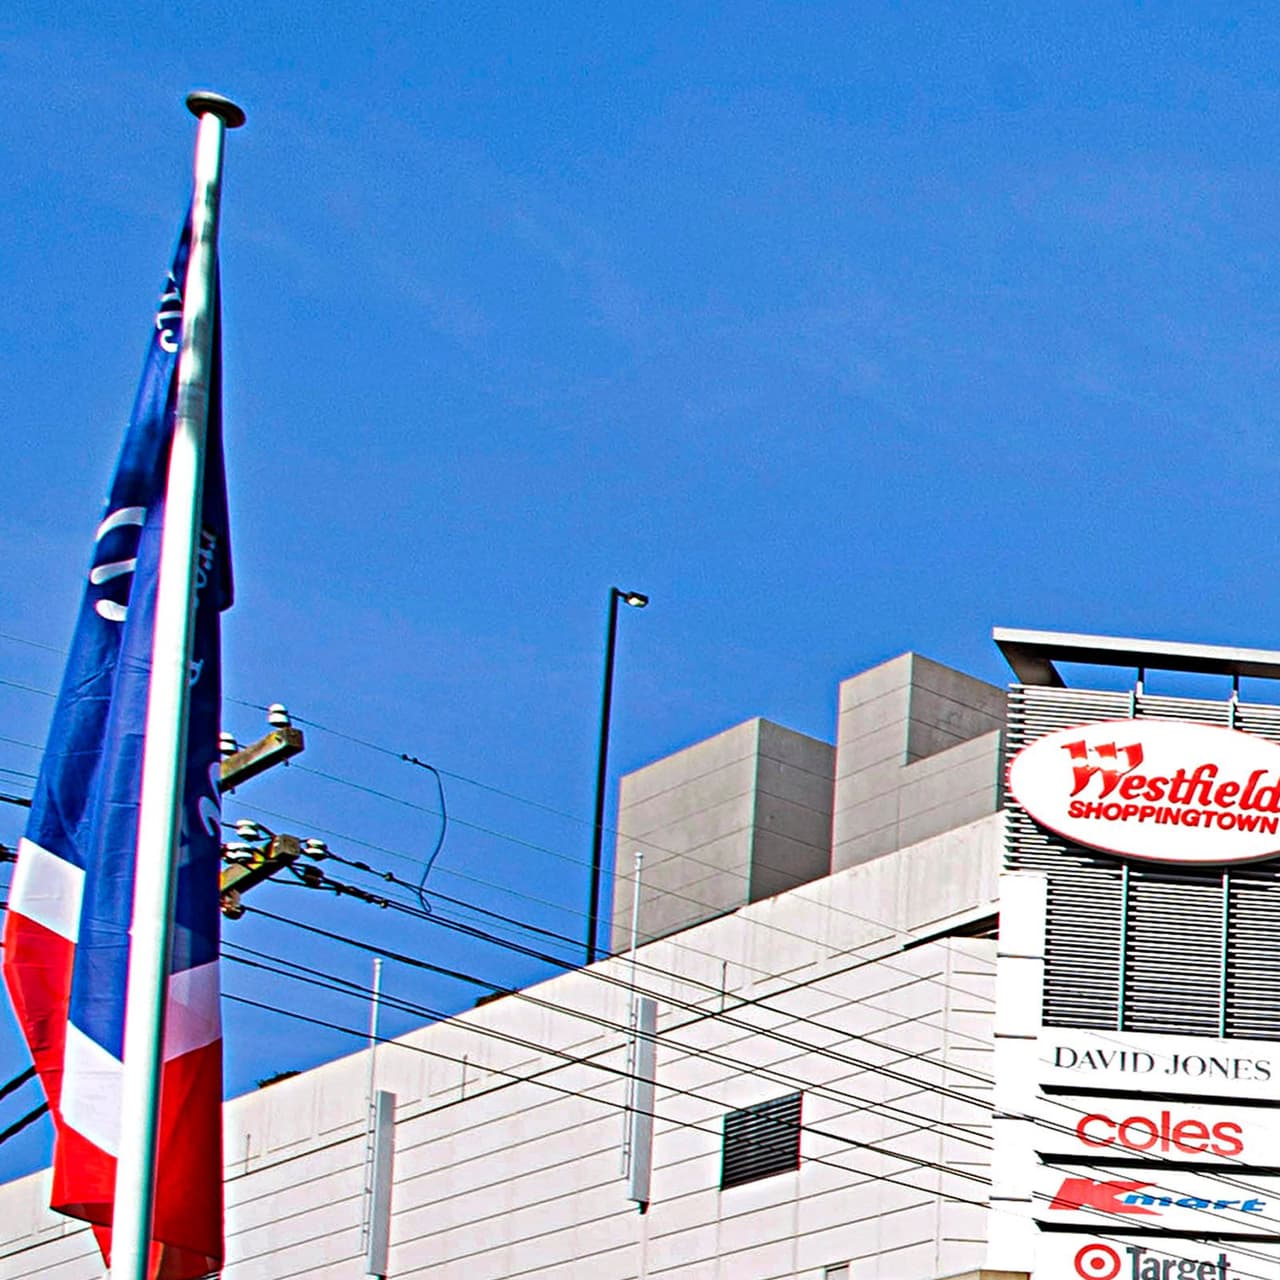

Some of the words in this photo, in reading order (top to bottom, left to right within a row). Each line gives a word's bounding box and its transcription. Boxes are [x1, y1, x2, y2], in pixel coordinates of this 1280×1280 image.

[1068, 801, 1279, 834] SHOPPINGTOWN
[1054, 1047, 1155, 1074] DAVID
[1164, 1054, 1272, 1081] JONES
[1077, 1111, 1244, 1156] coles
[1048, 1178, 1266, 1216] Kmart
